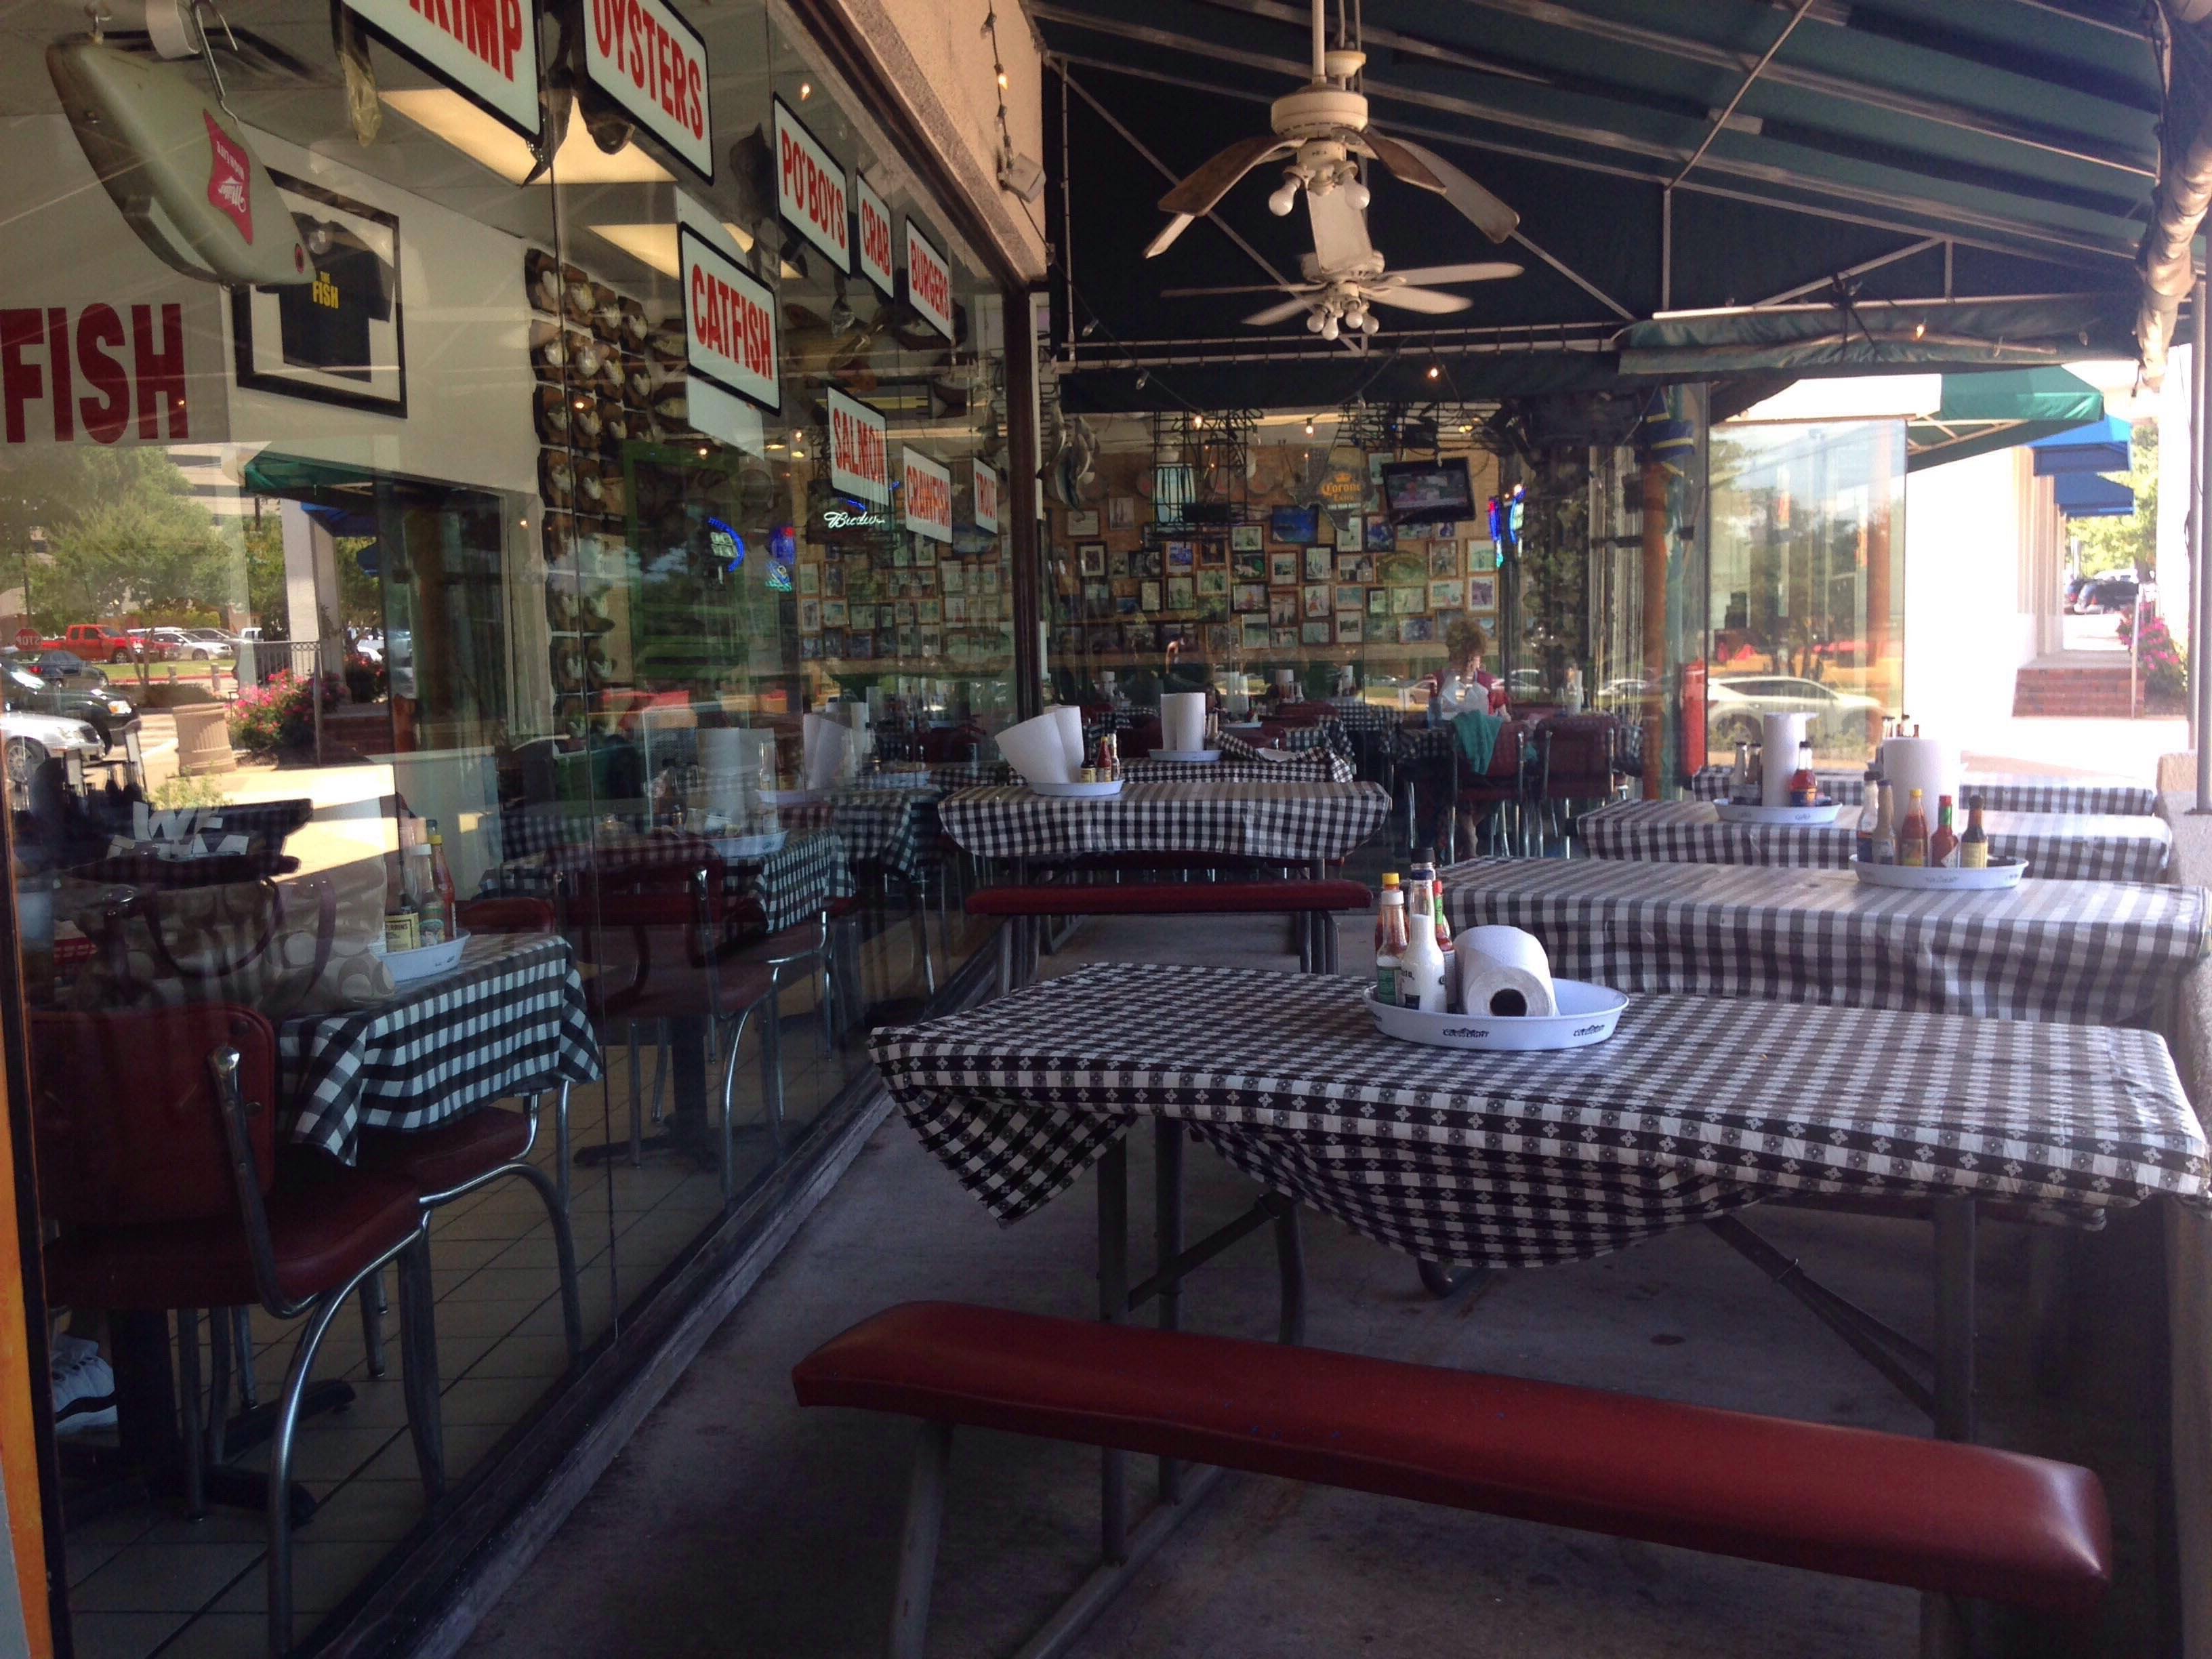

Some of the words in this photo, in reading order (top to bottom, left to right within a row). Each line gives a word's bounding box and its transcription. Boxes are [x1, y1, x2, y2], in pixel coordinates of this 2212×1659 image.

[593, 0, 703, 141] OYSTERS
[781, 126, 846, 249] PO'BOYS
[862, 199, 890, 277] CRAB
[910, 238, 949, 321] BURGERS
[312, 281, 339, 309] FISH
[692, 264, 773, 380] CATFISH
[0, 302, 188, 445] FISH
[834, 408, 886, 486] SALMON
[906, 465, 950, 529] CRAWFISH
